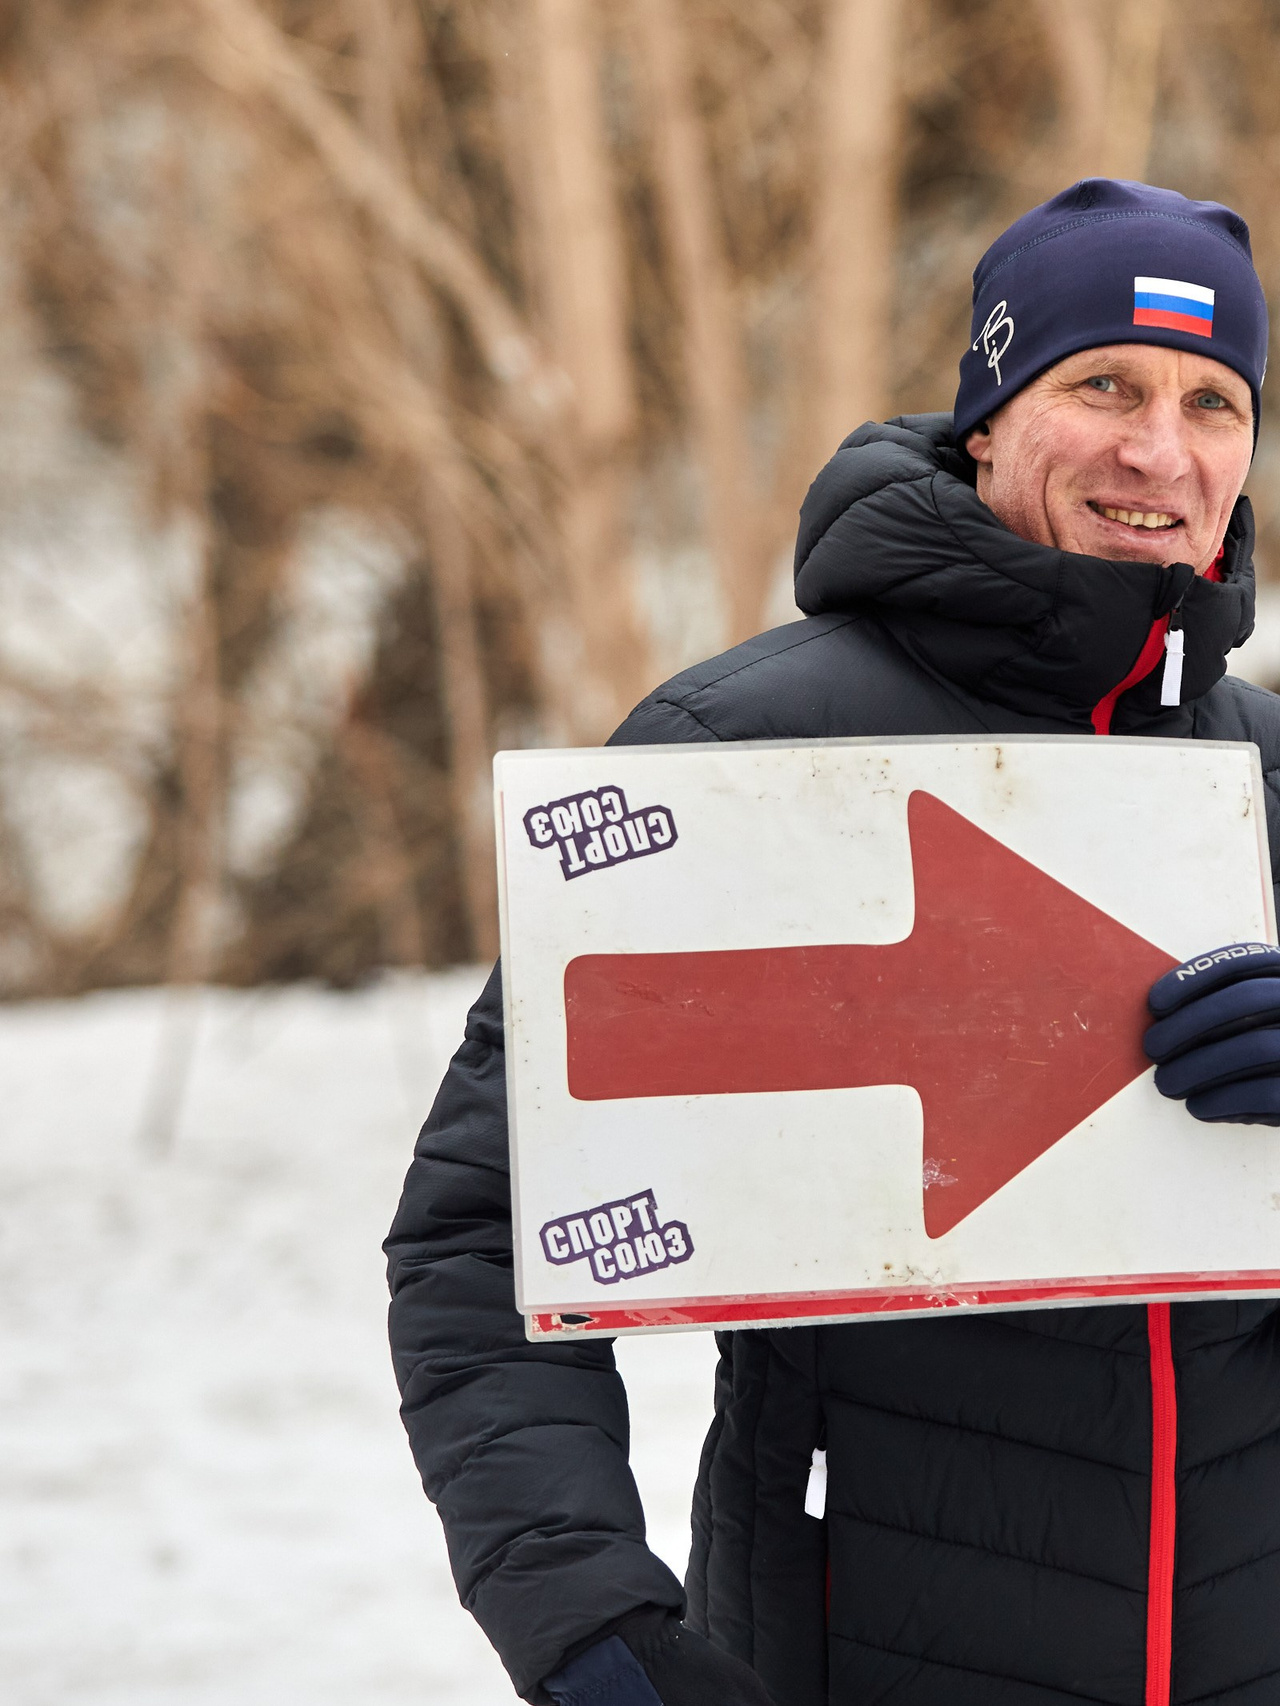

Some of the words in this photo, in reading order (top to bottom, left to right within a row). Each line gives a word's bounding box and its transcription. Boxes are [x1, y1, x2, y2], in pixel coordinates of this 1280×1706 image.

[530, 791, 624, 843] СОЮЗ
[564, 811, 672, 873] СПОРТ
[545, 1197, 653, 1259] СПОРТ
[593, 1227, 688, 1279] СОЮЗ
